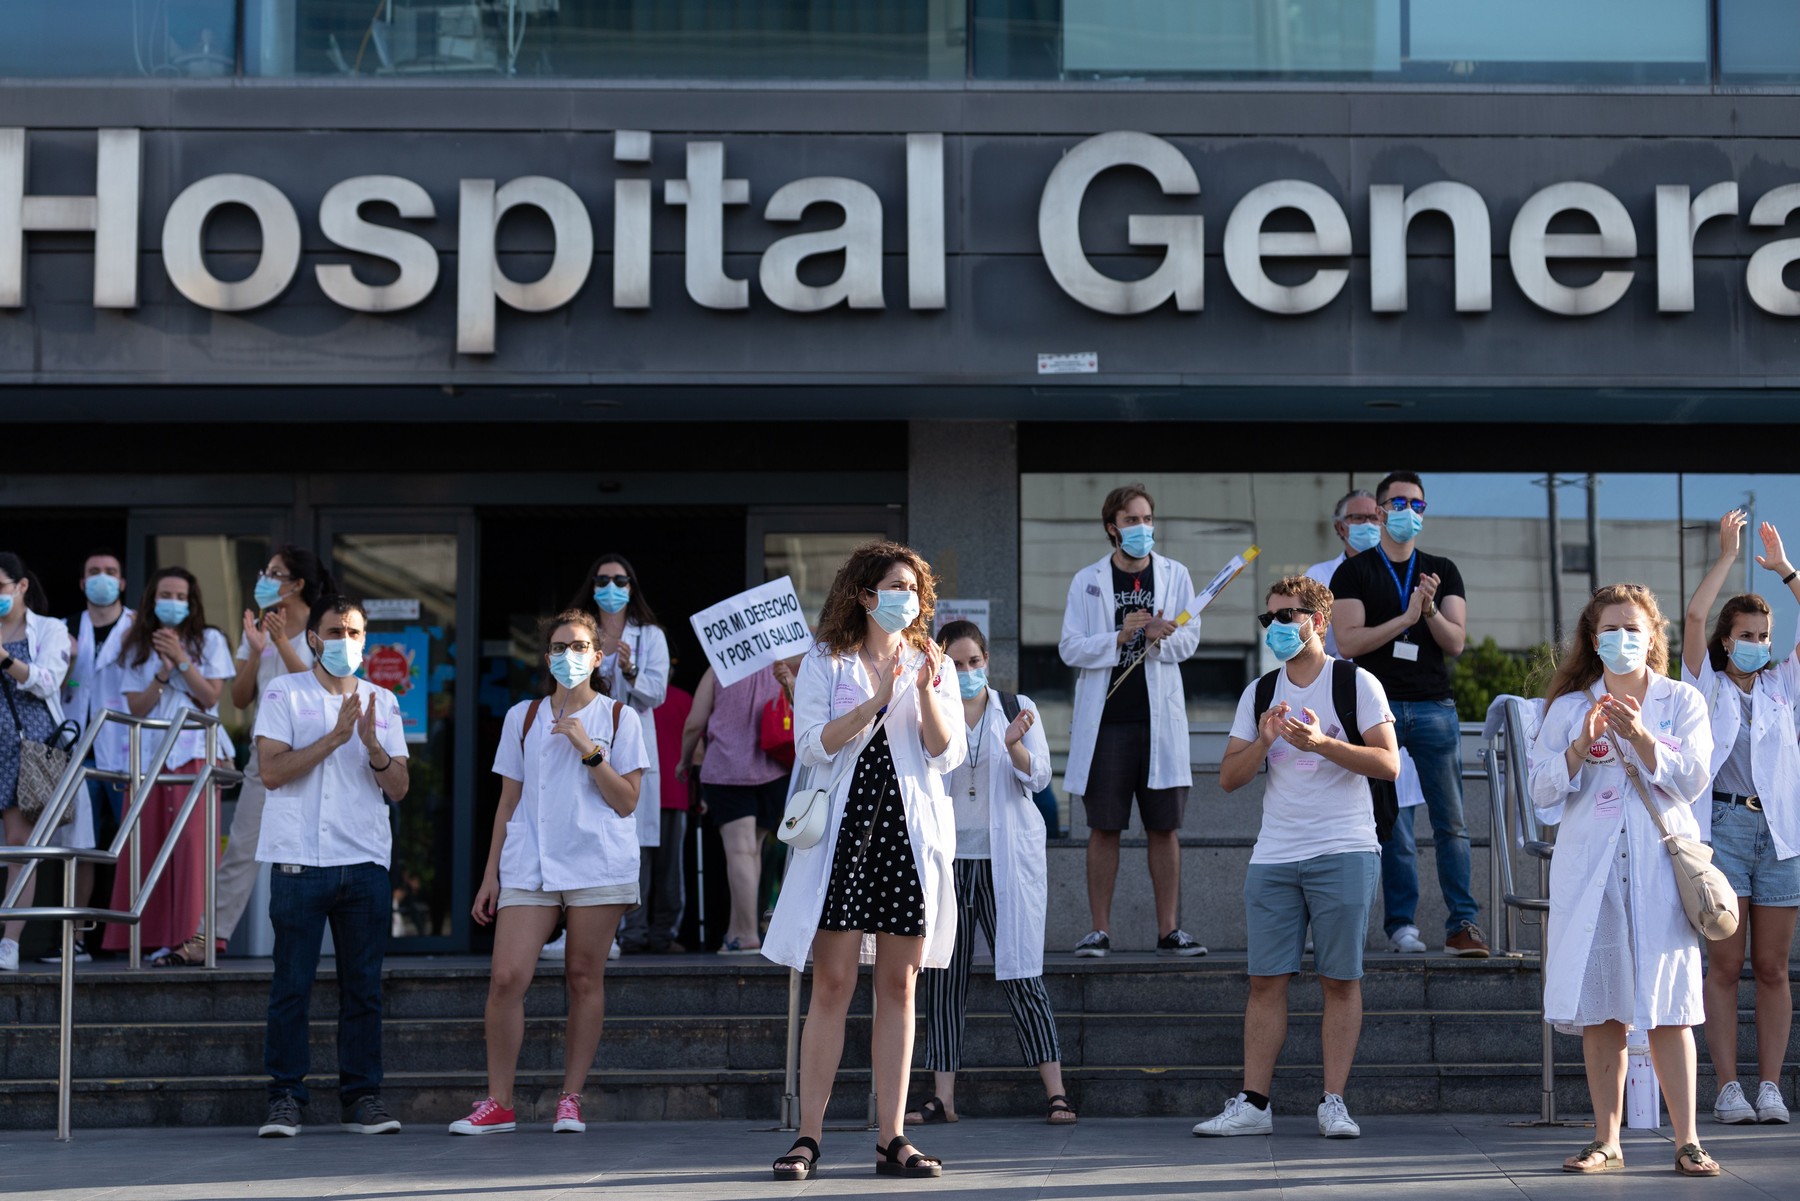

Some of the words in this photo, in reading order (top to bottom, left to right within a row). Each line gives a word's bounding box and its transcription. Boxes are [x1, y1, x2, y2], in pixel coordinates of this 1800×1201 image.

[0, 128, 946, 354] Hospital
[703, 618, 733, 645] POR
[729, 611, 747, 633] MI
[744, 593, 798, 626] DERECHO
[716, 651, 728, 670] Y
[726, 640, 756, 666] POR
[751, 631, 771, 653] TU
[769, 621, 809, 646] SALUD.
